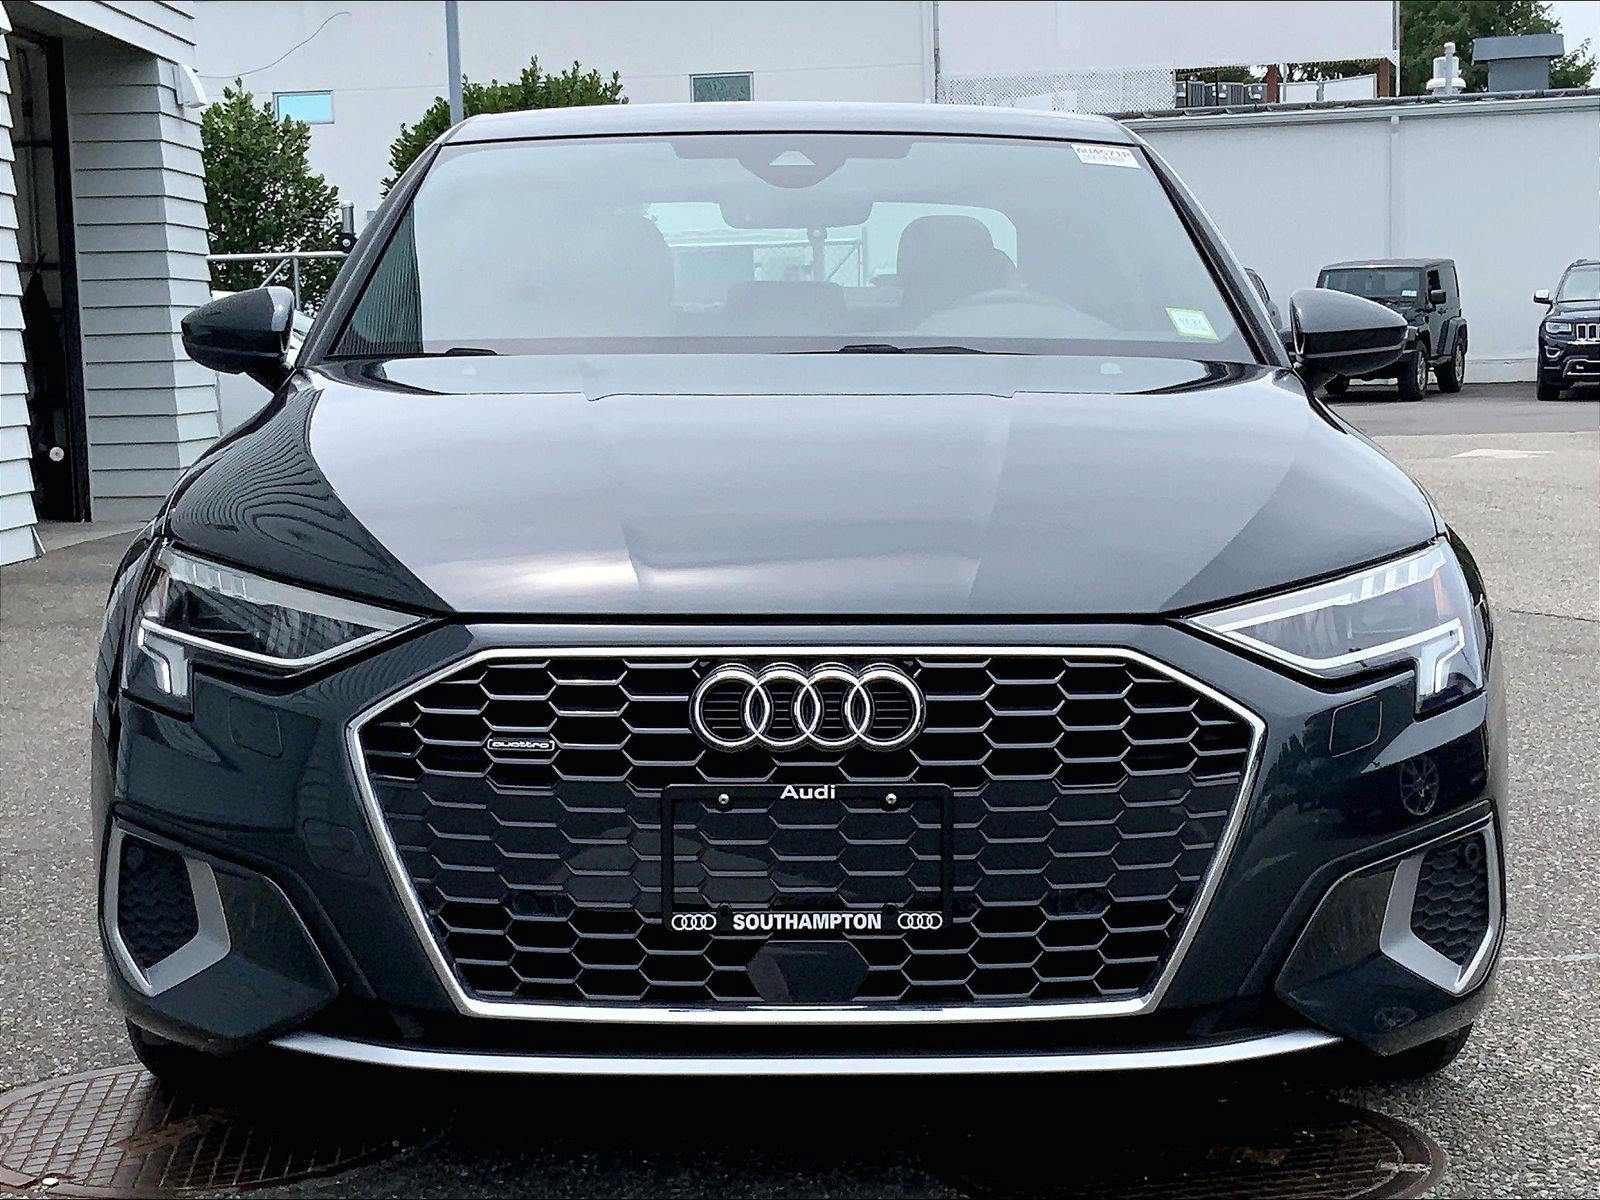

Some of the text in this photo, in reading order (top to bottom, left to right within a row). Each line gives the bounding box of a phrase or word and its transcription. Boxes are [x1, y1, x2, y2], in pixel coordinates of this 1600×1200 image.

[491, 741, 550, 749] quattro
[780, 784, 836, 799] Audi
[732, 913, 882, 930] SOUTHAMPTON
